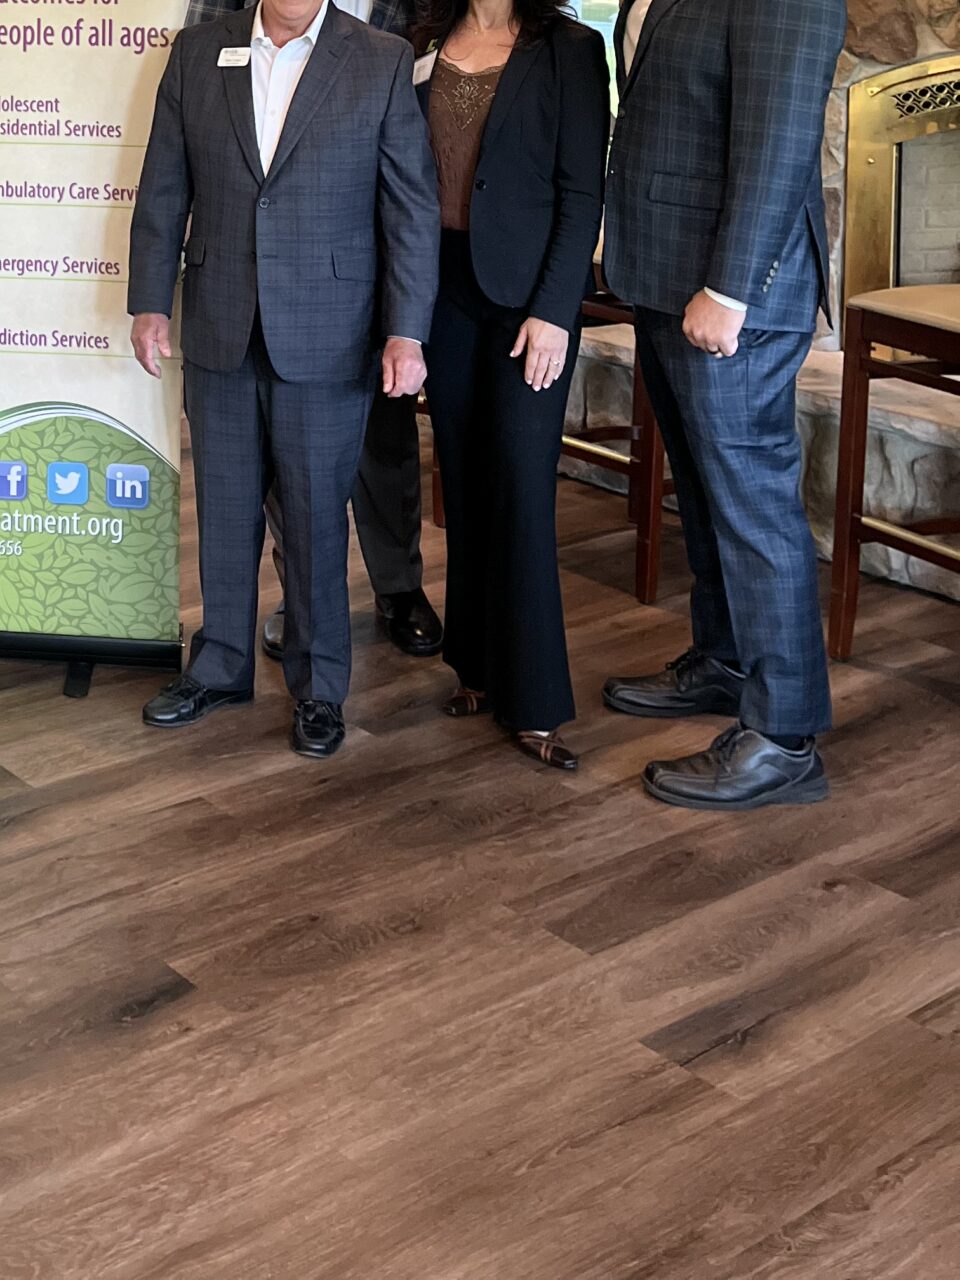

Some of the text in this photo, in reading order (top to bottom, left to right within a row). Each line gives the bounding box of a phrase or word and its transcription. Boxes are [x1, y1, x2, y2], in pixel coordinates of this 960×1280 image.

[61, 18, 84, 46] of
[88, 18, 113, 47] all
[64, 120, 122, 138] Services
[69, 182, 99, 200] Care
[103, 183, 140, 201] Servi
[62, 256, 120, 275] Services
[51, 330, 109, 349] Services
[7, 465, 22, 496] f
[115, 471, 143, 499] in
